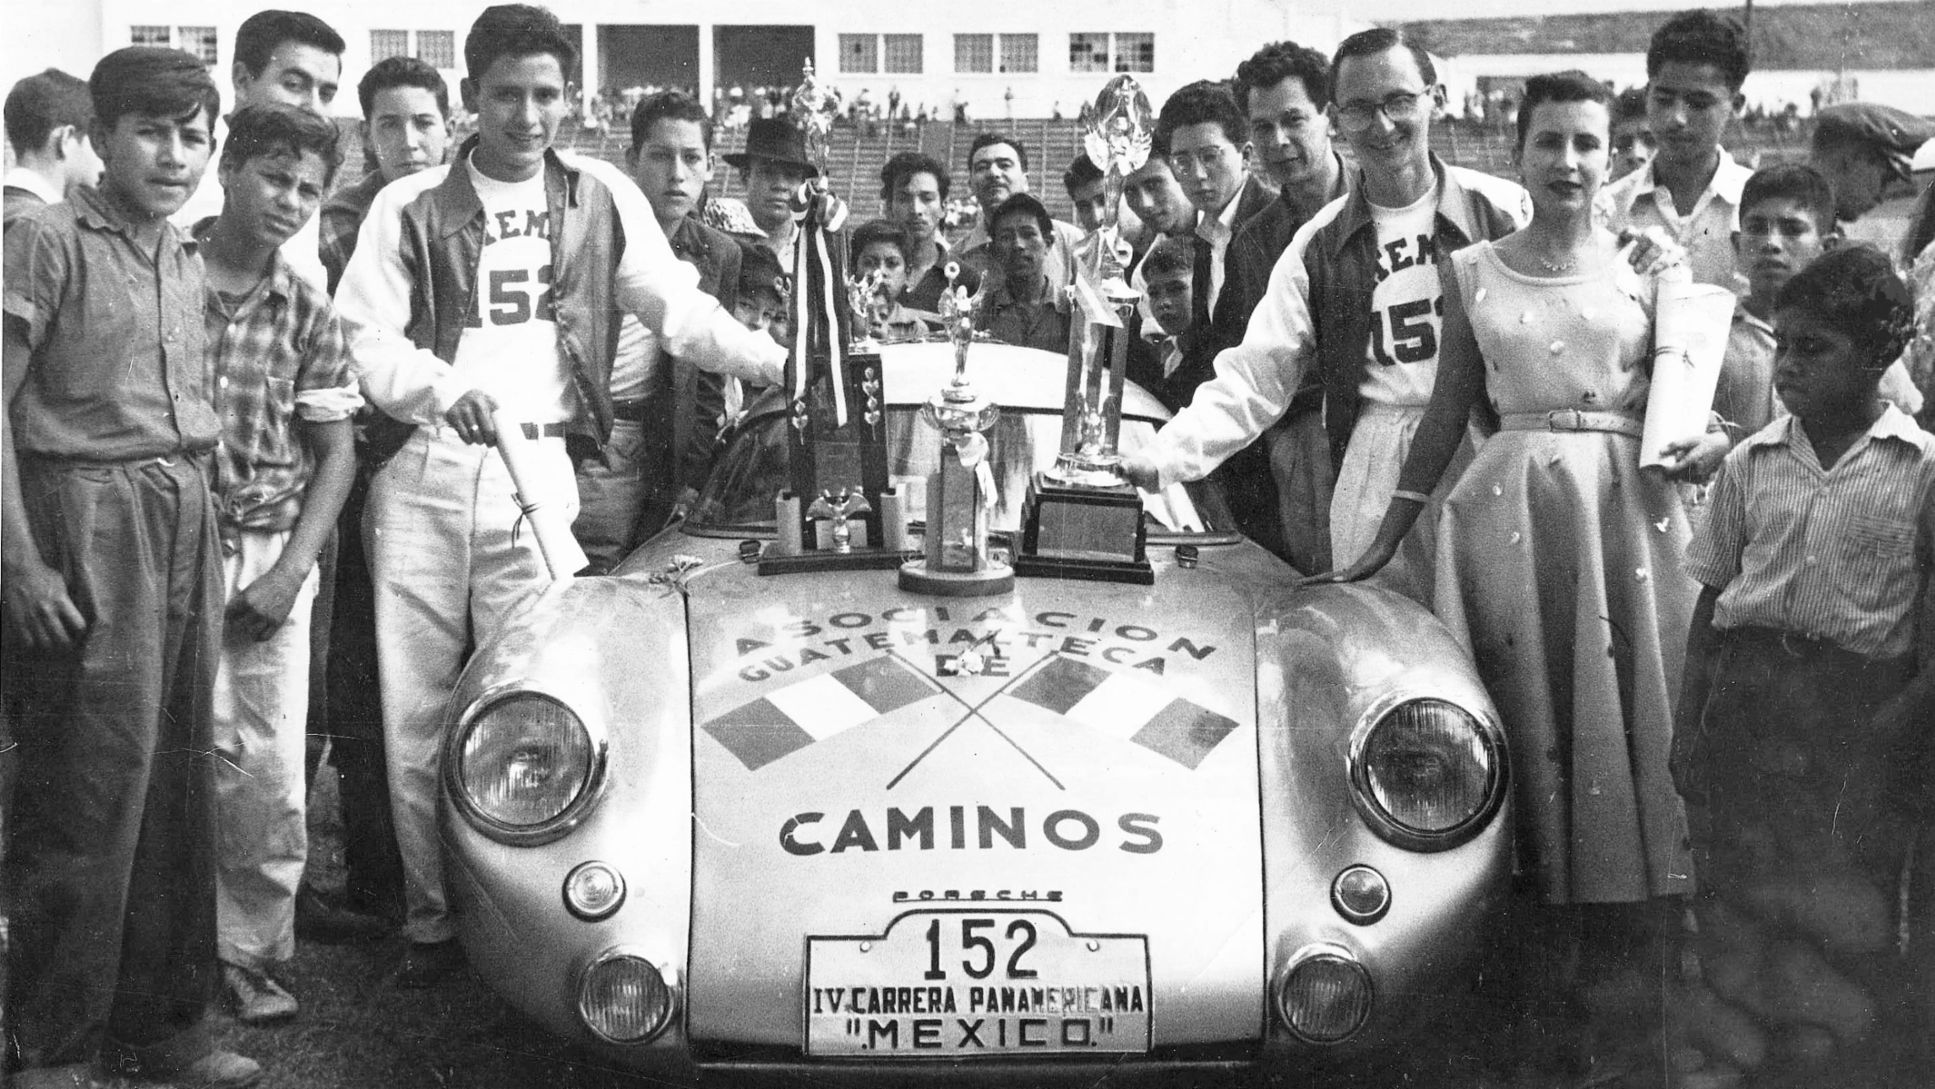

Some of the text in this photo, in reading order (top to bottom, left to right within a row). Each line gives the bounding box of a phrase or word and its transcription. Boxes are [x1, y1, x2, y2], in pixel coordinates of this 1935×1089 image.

[1369, 295, 1443, 367] 15
[735, 606, 1216, 660] ASOCIACION
[779, 805, 1164, 856] CAMINOS
[892, 890, 1063, 902] PORSCHE
[924, 918, 1038, 980] 152
[813, 986, 1144, 1014] IV CARRERA PANAMERICANA
